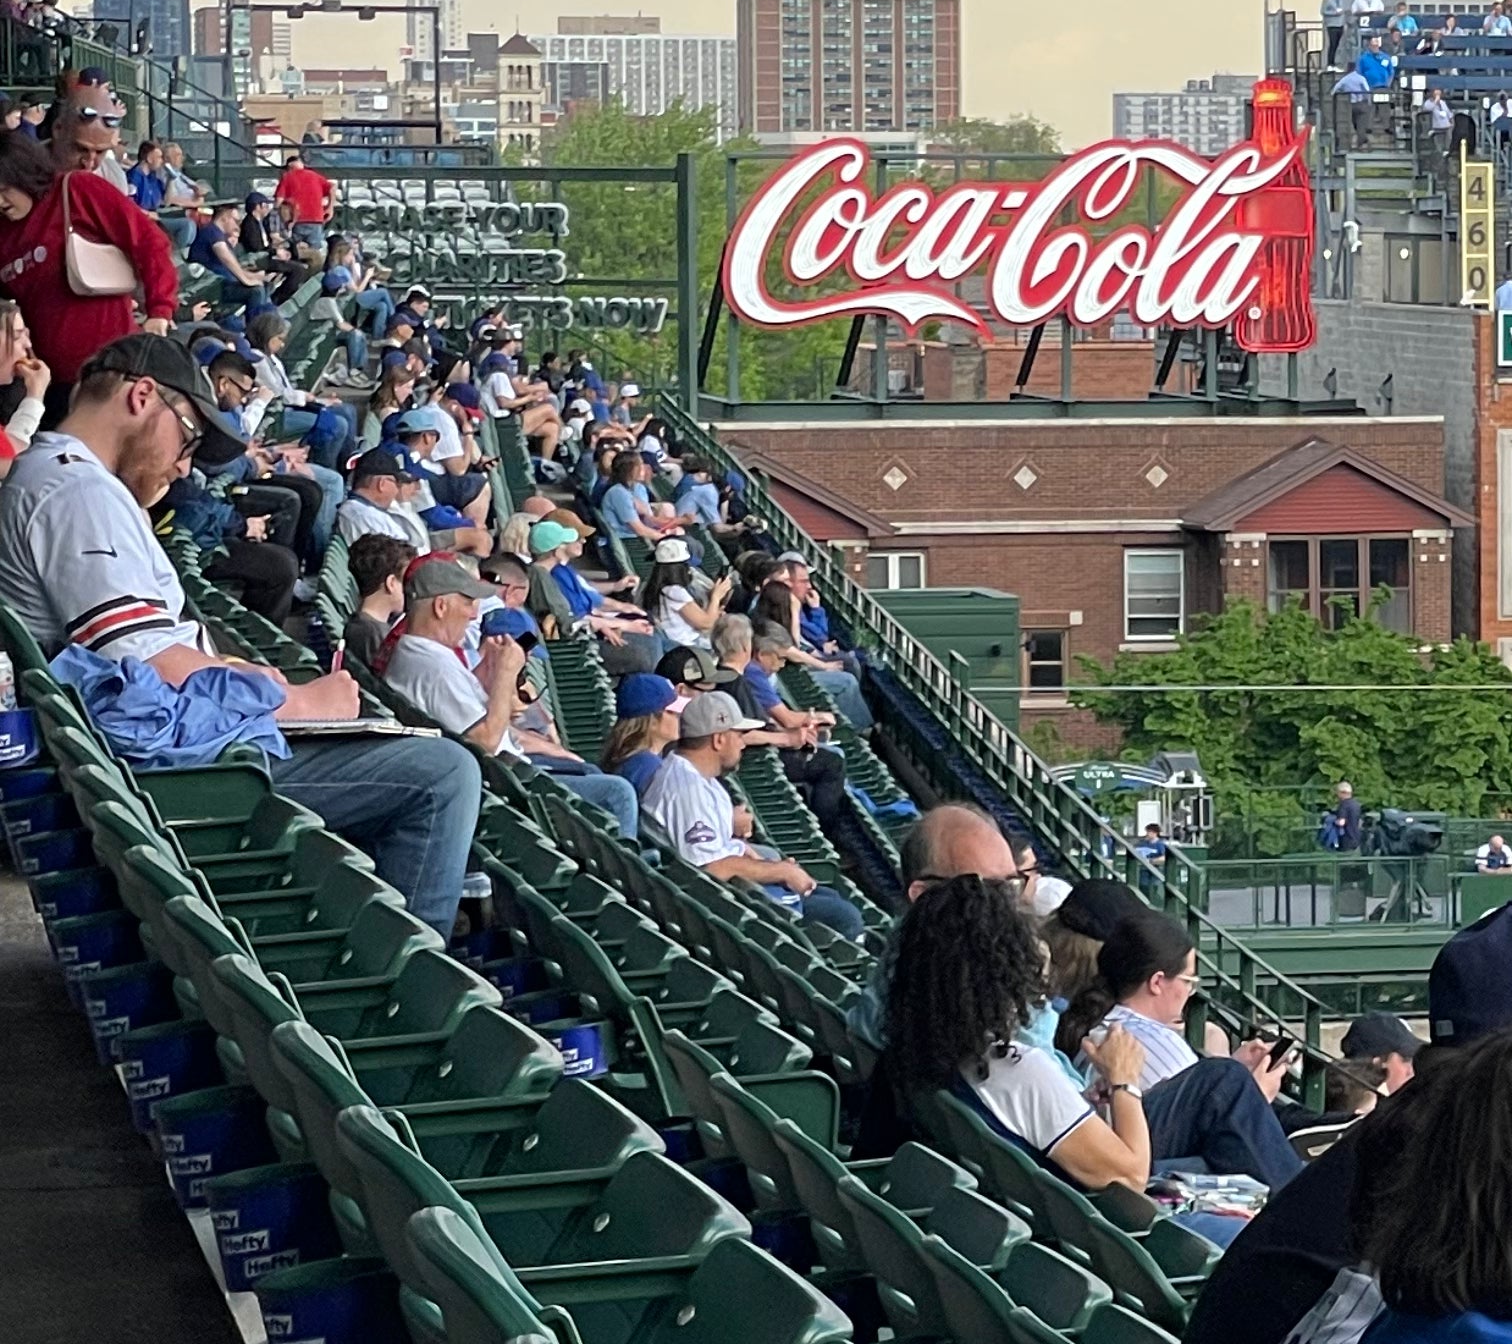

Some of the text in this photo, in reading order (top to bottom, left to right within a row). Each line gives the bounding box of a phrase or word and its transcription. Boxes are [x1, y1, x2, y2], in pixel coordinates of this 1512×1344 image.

[471, 202, 570, 236] YOUR
[727, 142, 1300, 328] Coca-Cola
[1468, 177, 1486, 292] 460
[579, 297, 669, 333] NOW
